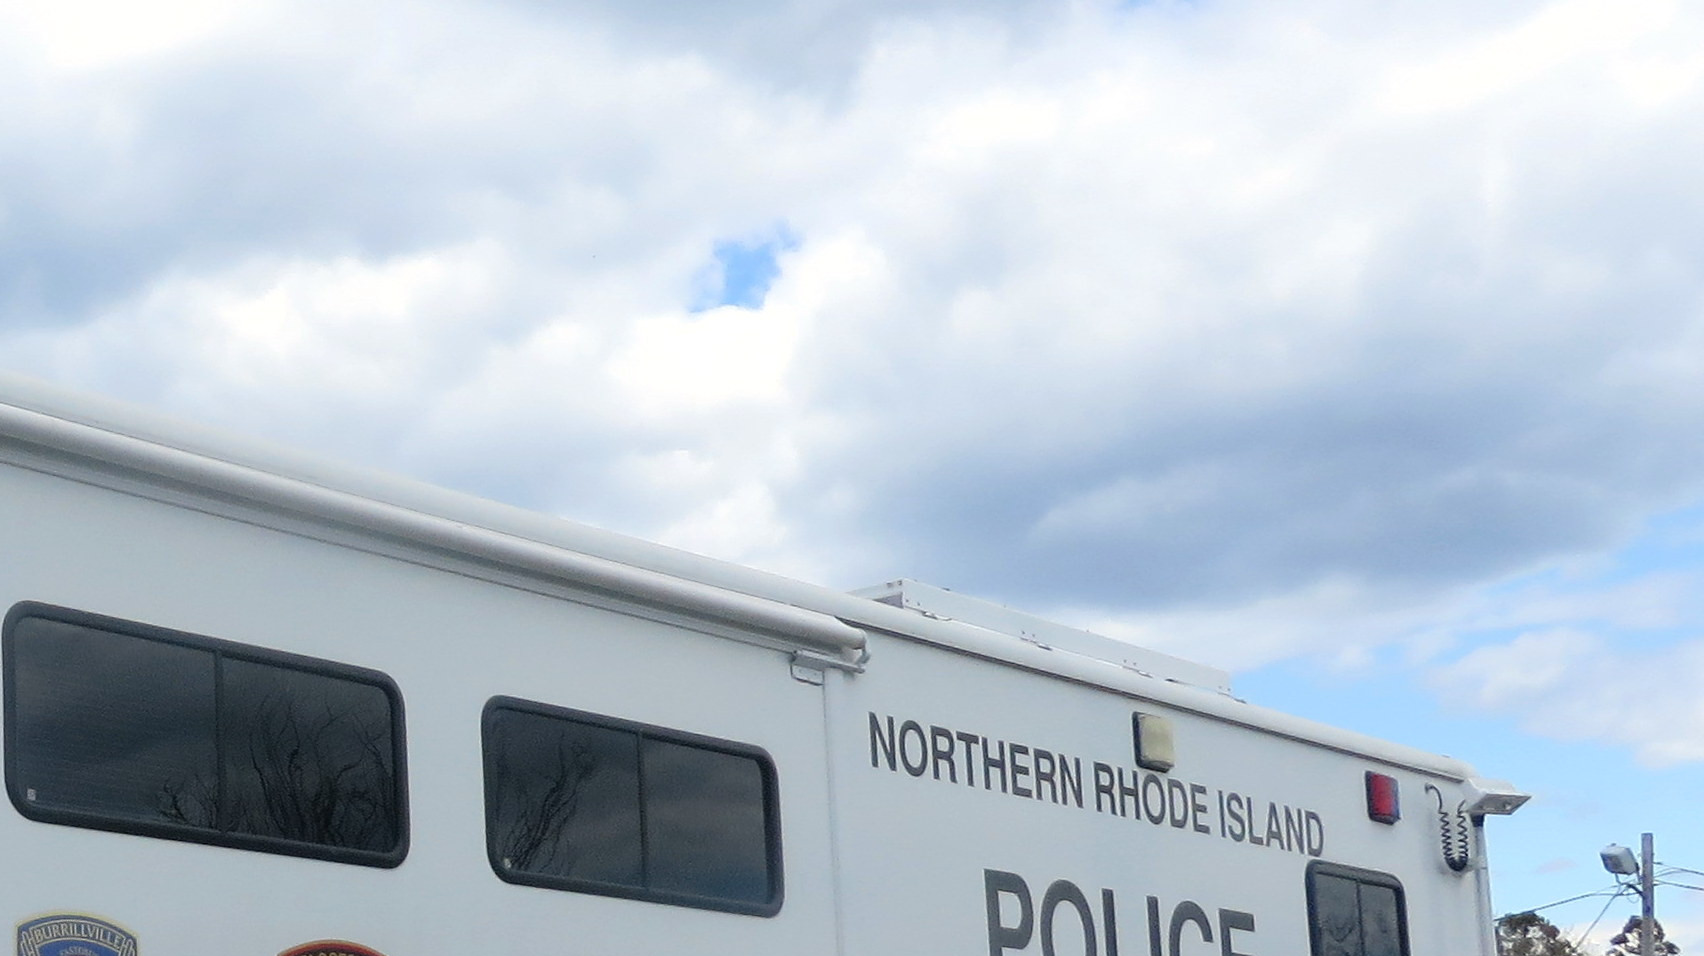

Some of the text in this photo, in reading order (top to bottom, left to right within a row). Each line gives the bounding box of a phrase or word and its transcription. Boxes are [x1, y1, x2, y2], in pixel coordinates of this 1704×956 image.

[869, 711, 1325, 859] NORTHERN RHODE ISLAND
[35, 922, 123, 950] BURRILLVILLE
